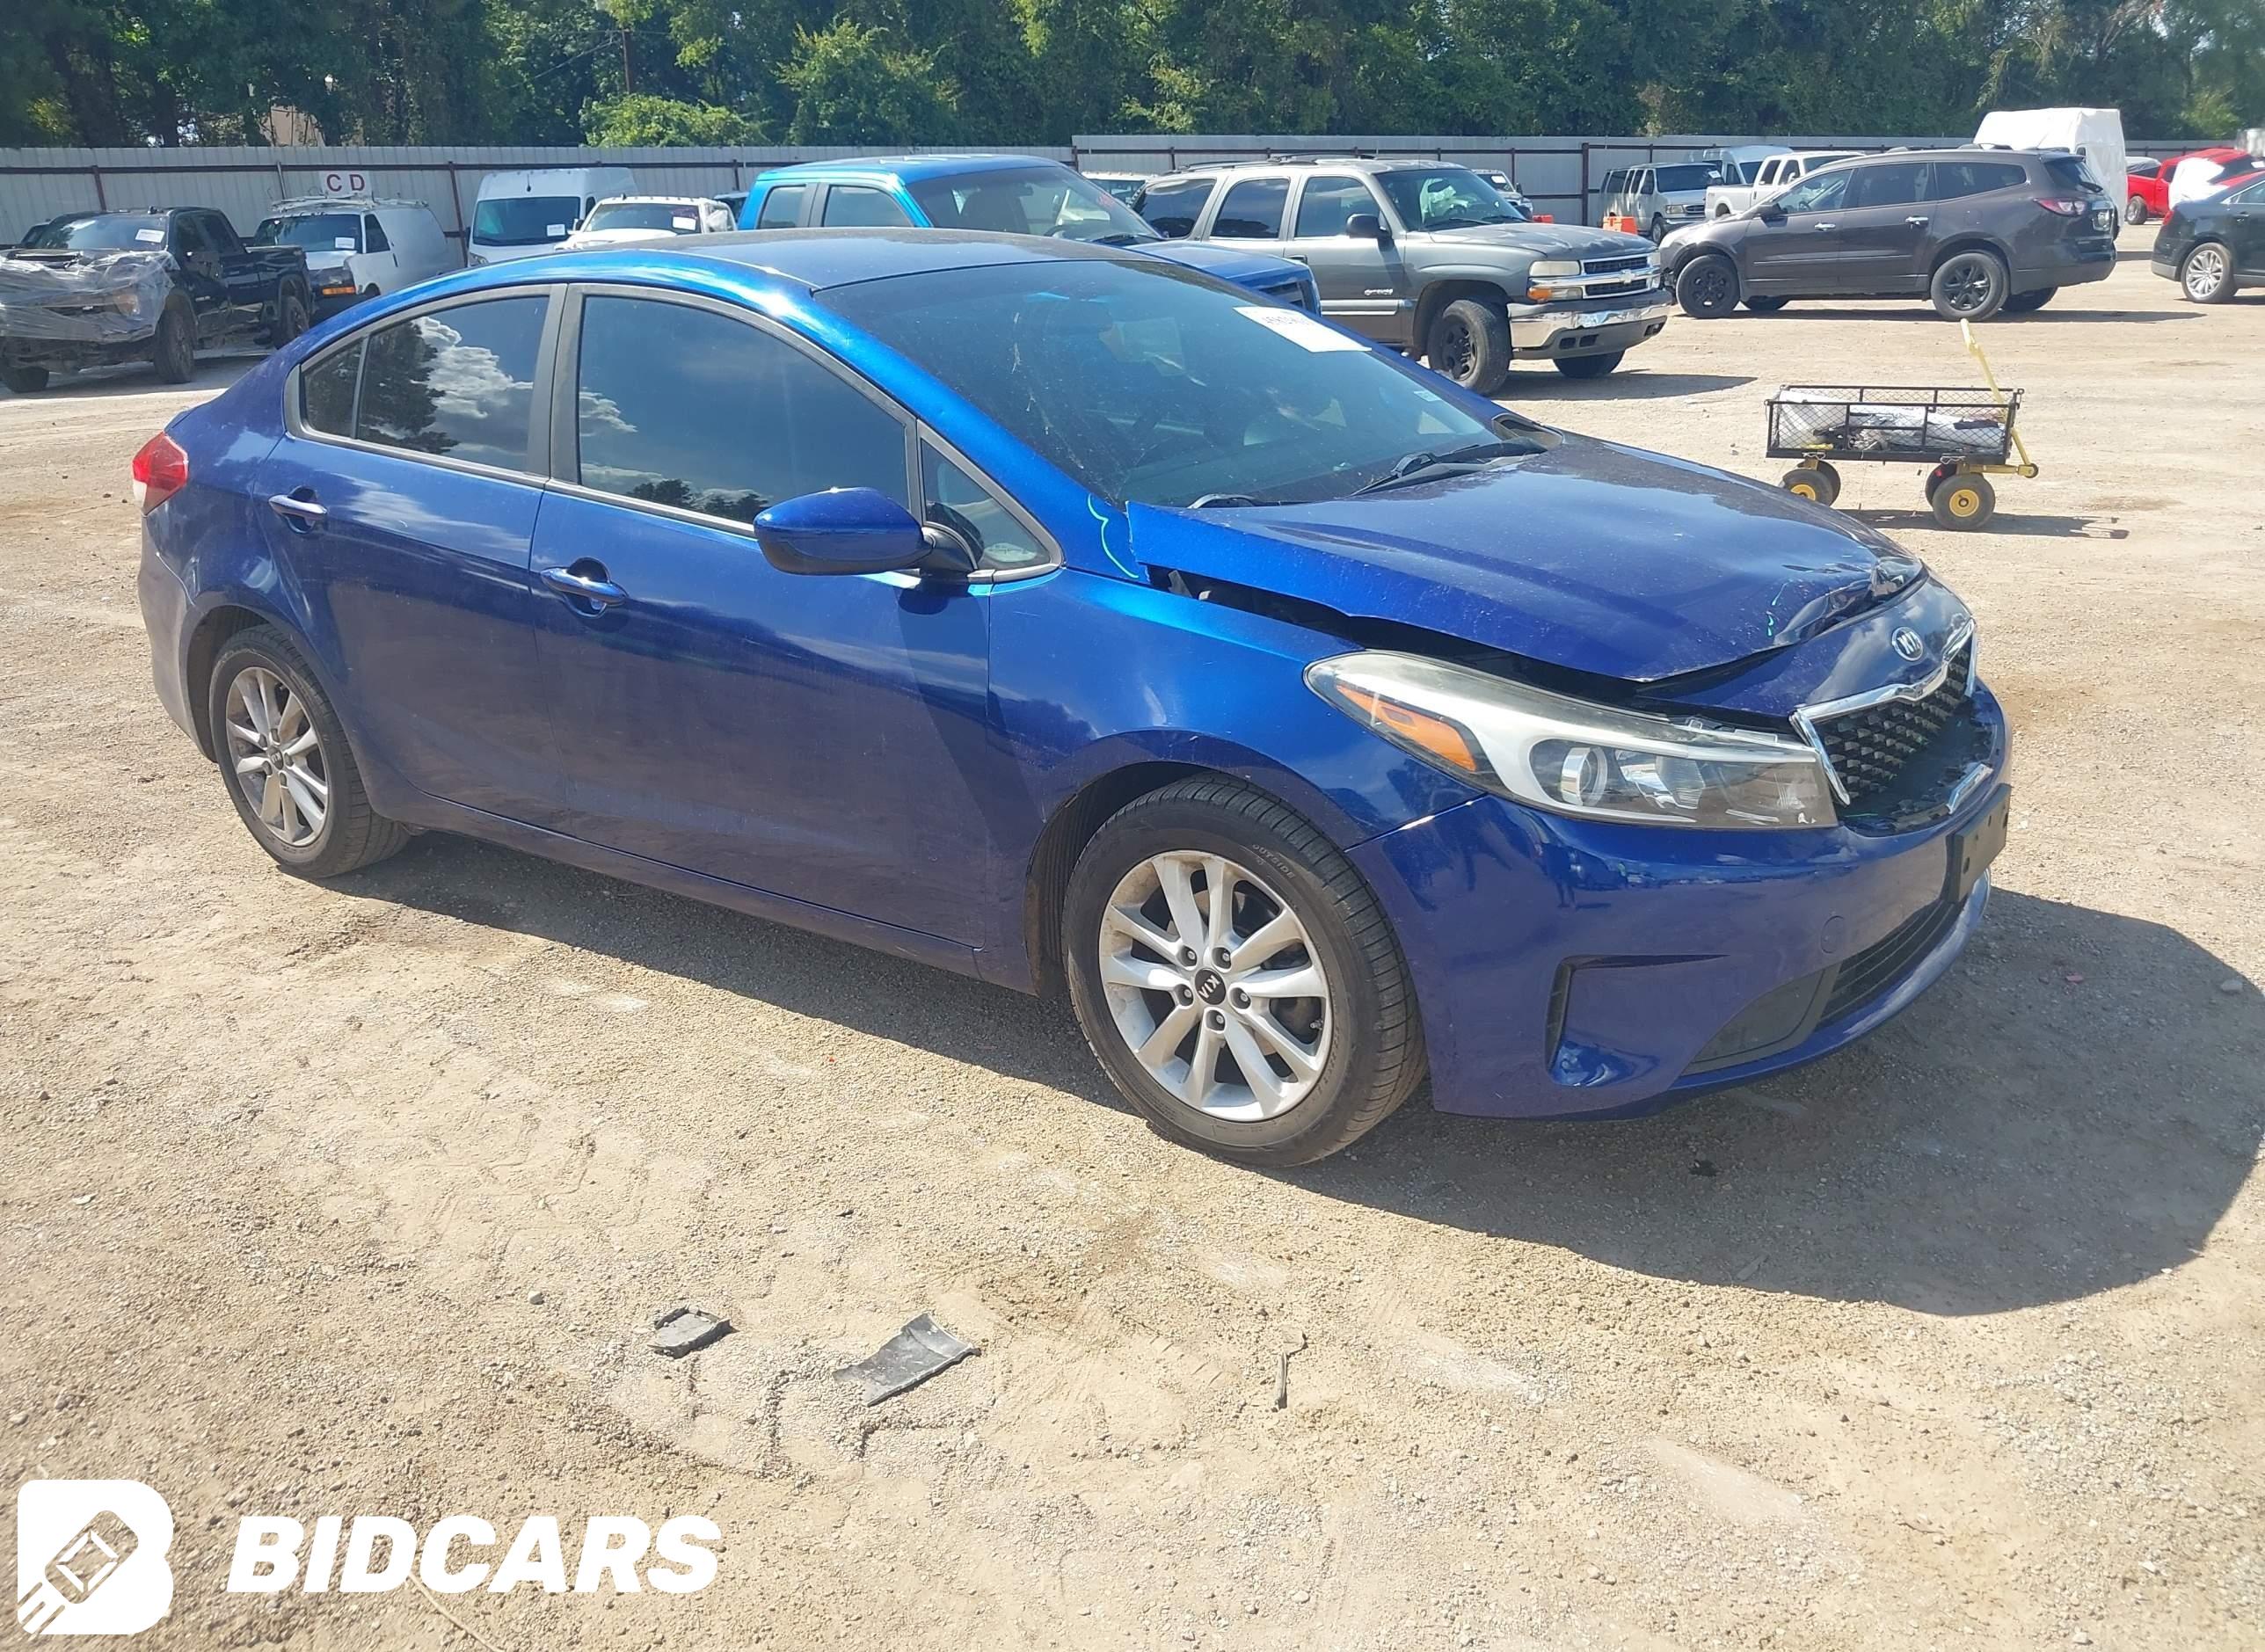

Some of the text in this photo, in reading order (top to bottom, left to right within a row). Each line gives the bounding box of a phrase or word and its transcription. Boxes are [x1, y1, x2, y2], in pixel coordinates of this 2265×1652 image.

[326, 173, 365, 193] C D
[1252, 844, 1294, 879] OUTSIDE
[1198, 974, 1220, 999] KIA
